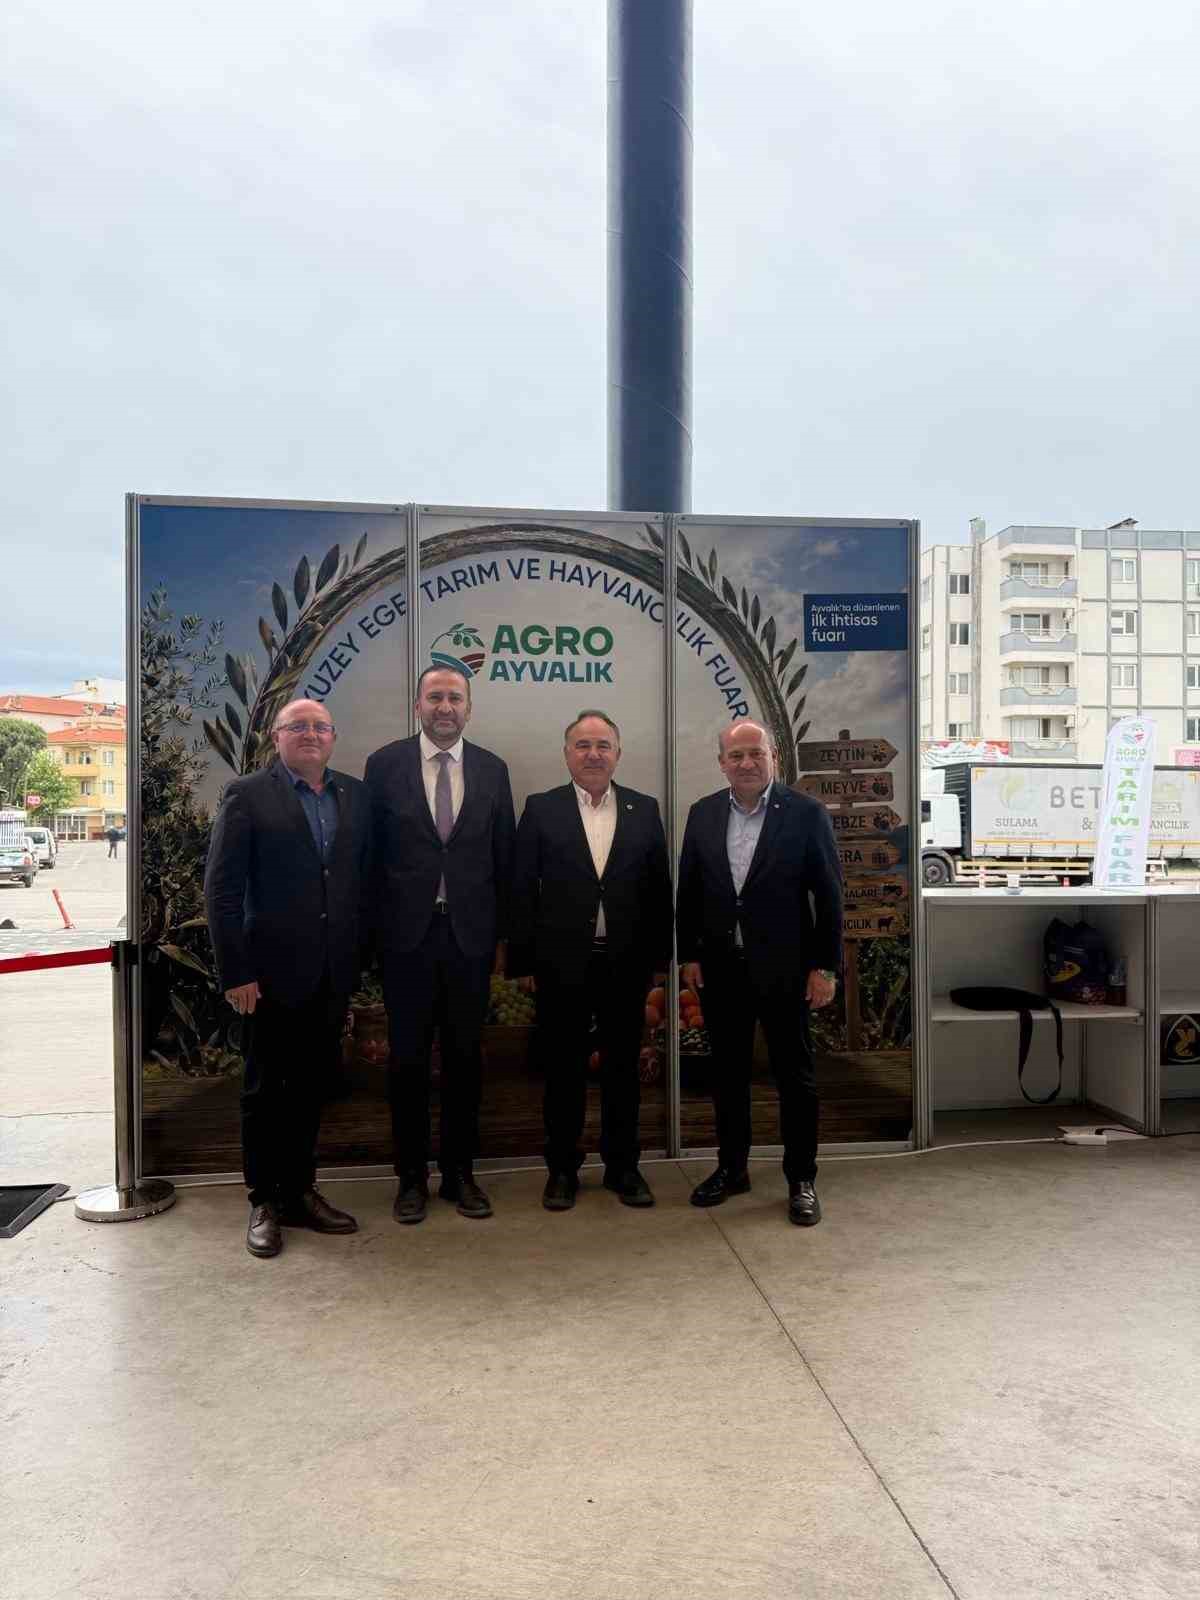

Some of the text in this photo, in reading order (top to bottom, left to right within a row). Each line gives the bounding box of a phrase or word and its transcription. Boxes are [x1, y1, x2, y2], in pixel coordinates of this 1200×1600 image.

[811, 613, 879, 627] ilk ihtisas
[357, 593, 407, 640] EGE
[419, 560, 501, 602] TARIM
[506, 558, 541, 580] VE
[705, 653, 750, 721] FUAR
[490, 623, 615, 657] AGRO
[811, 628, 846, 642] fuarı
[489, 660, 614, 683] AYVALIK
[819, 747, 866, 762] ZEYTİN
[820, 780, 868, 796] MEYVE
[1049, 785, 1102, 809] BET
[832, 814, 867, 830] EBZE
[994, 817, 1038, 828] SULAMA
[1150, 820, 1191, 831] ANCILIK
[839, 849, 864, 864] ERA
